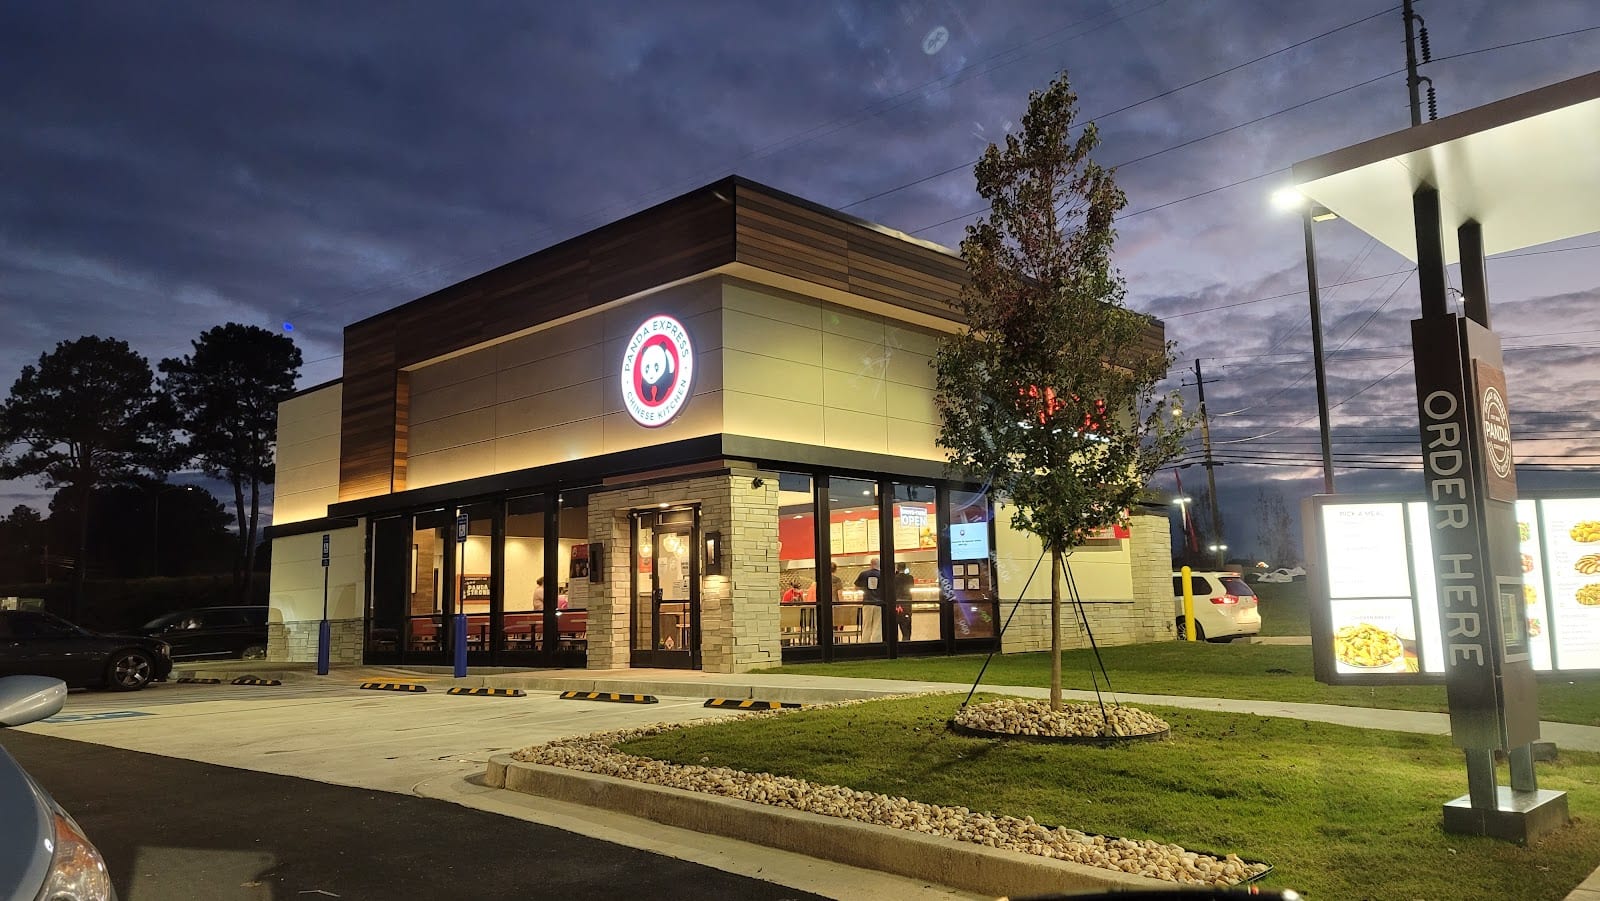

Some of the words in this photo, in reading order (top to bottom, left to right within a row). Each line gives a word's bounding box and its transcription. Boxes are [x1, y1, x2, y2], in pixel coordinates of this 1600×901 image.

[624, 327, 650, 372] PANDA
[652, 320, 689, 359] EXPRESS
[626, 391, 655, 421] CHINESE
[657, 379, 687, 420] KITCHEN
[1485, 420, 1510, 445] PANDA
[1423, 390, 1469, 530] ORDER
[902, 515, 926, 526] OPEN
[1439, 552, 1484, 667] HERE
